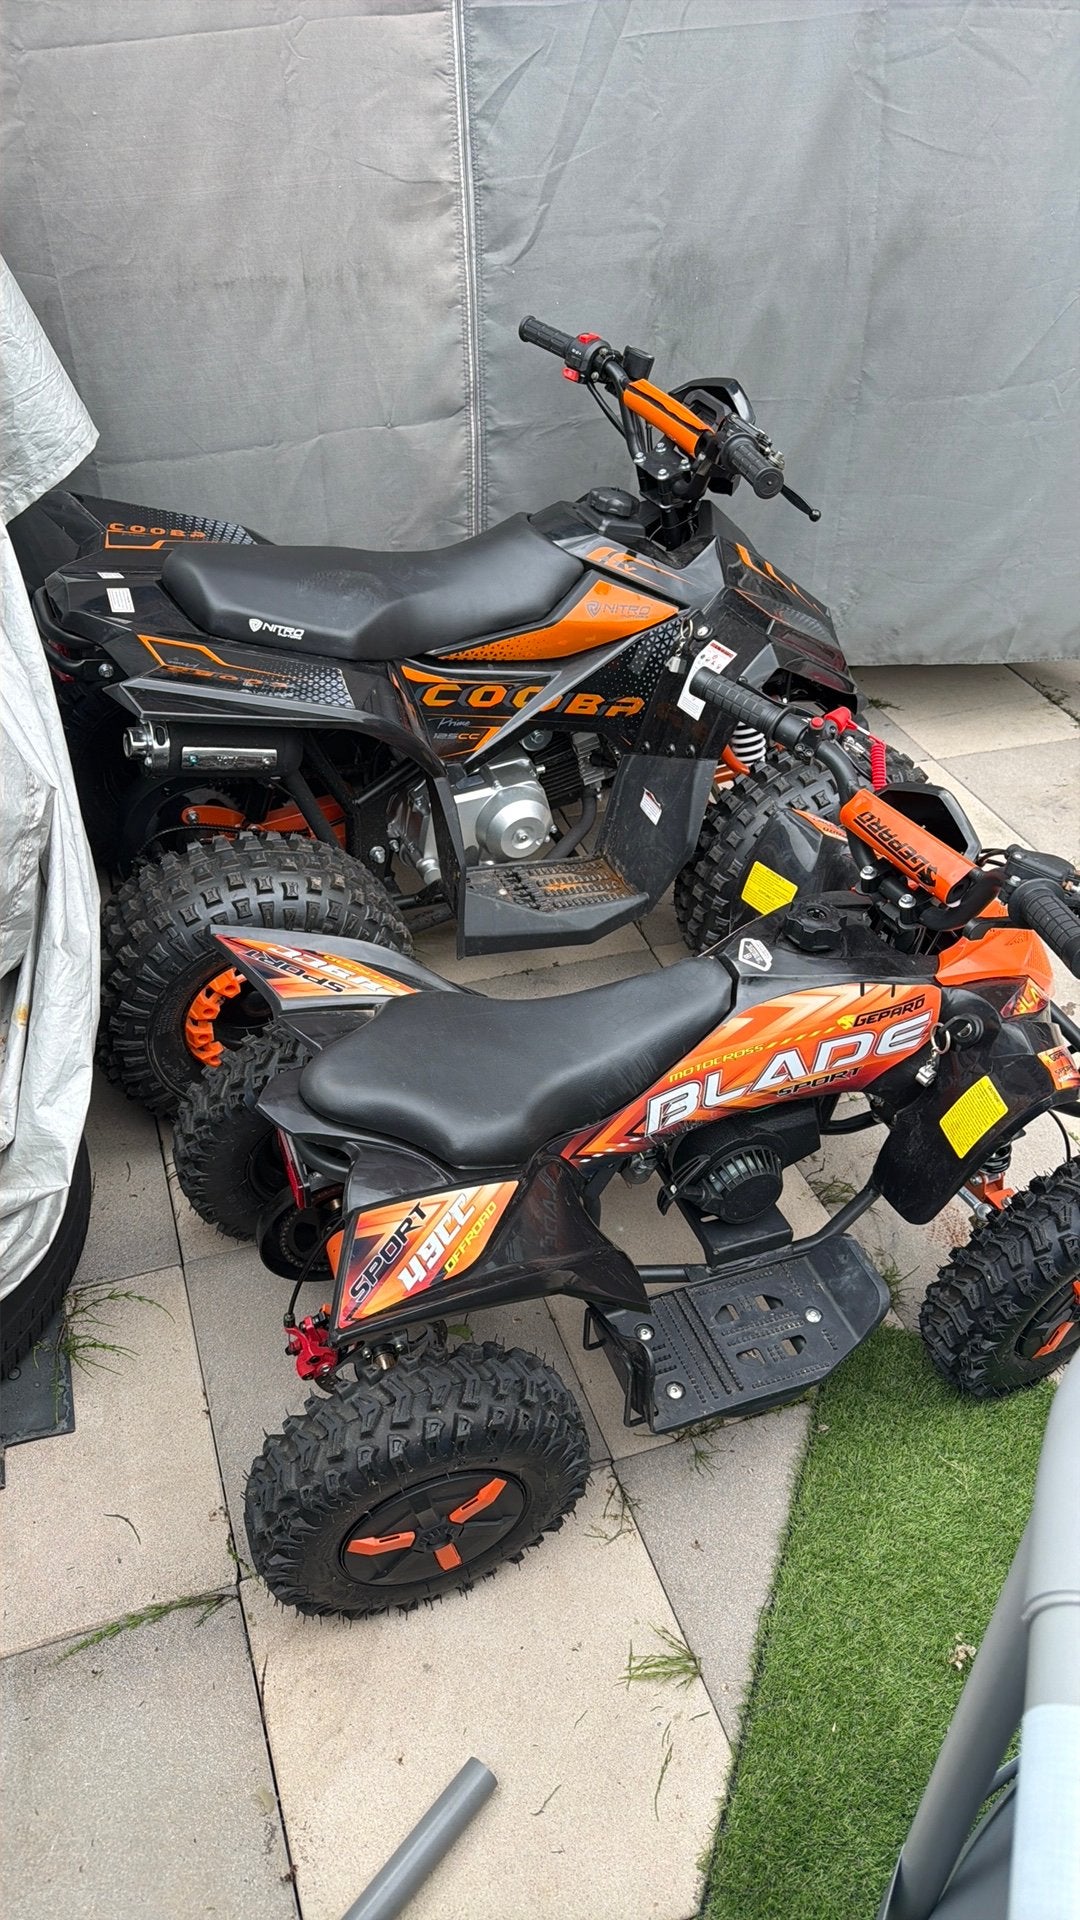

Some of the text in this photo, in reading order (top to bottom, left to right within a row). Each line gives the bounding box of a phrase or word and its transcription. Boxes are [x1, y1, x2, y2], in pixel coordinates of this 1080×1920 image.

[109, 522, 206, 538] COOBA
[602, 602, 650, 615] NITRO
[262, 622, 305, 637] NITRO
[418, 684, 646, 717] COOBA
[429, 716, 471, 729] Prime
[433, 732, 480, 740] 125CC
[853, 811, 930, 873] GEPARD
[244, 949, 347, 993] SPORT
[853, 994, 926, 1027] GEPARD
[644, 1008, 934, 1137] BLADE
[669, 1043, 765, 1083] MOTOCROSS
[777, 1066, 864, 1098] SPORT
[349, 1201, 428, 1303] SPORT
[443, 1201, 497, 1274] OFFROAD
